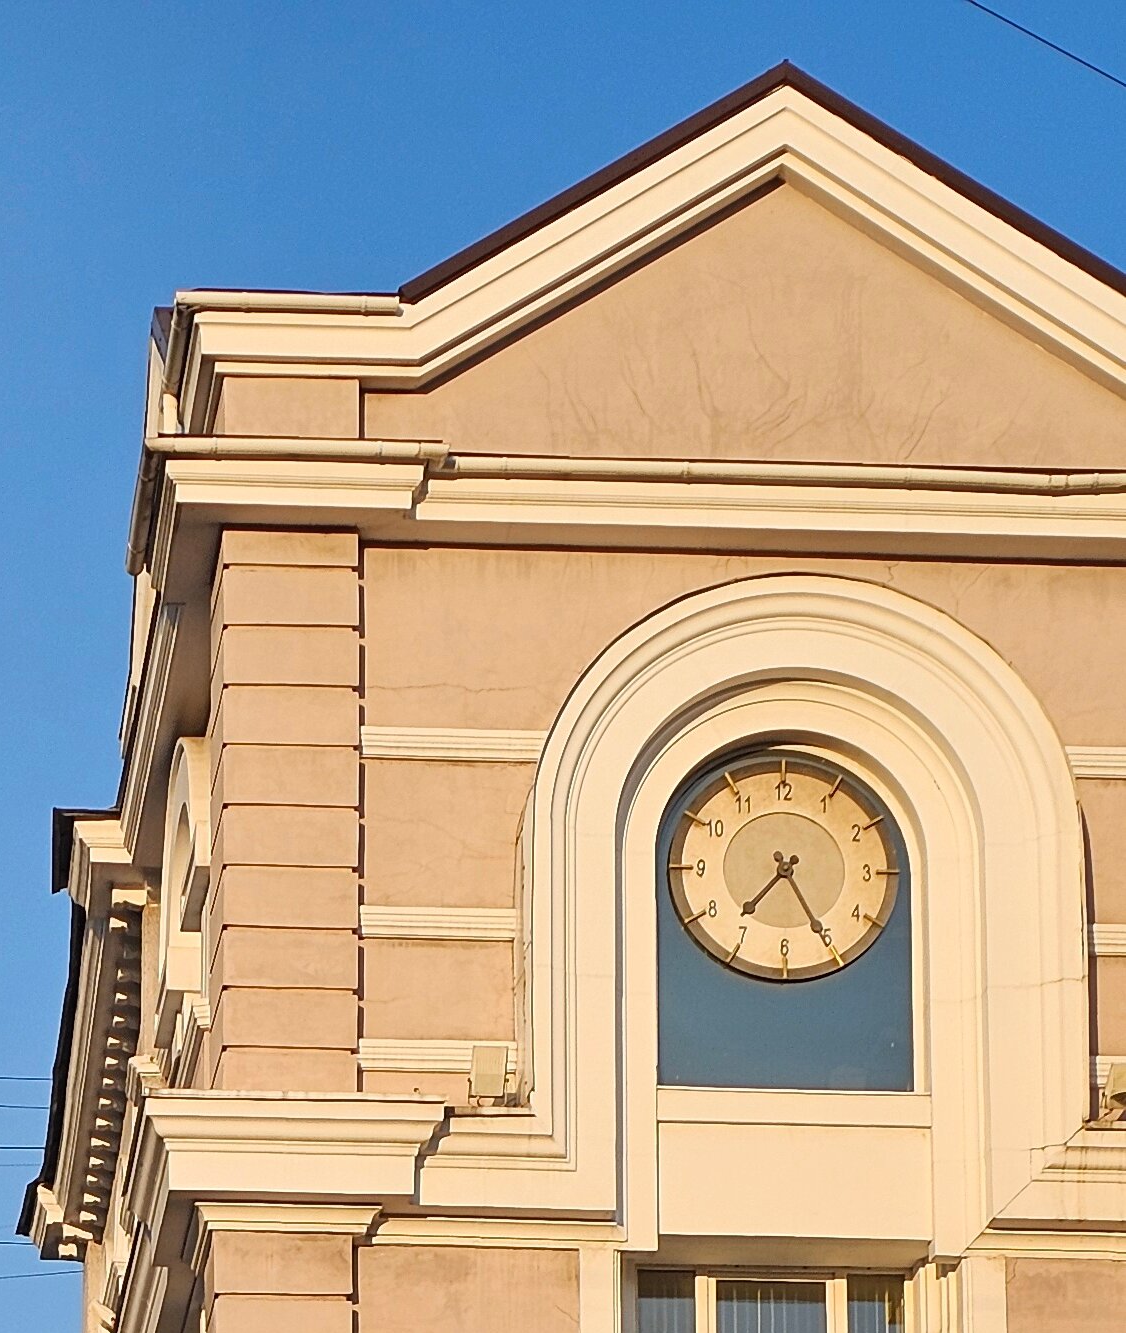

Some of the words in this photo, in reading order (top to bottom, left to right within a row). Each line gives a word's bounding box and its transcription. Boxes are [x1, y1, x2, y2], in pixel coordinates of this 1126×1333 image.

[774, 782, 792, 800] 12
[735, 795, 751, 813] 11
[820, 797, 828, 813] 1
[706, 819, 724, 837] 10
[851, 824, 861, 842] 2
[696, 859, 706, 877] 9
[862, 864, 872, 882] 3
[708, 900, 718, 917] 8
[851, 904, 860, 922] 4
[738, 926, 748, 944] 7
[780, 938, 789, 956] 6
